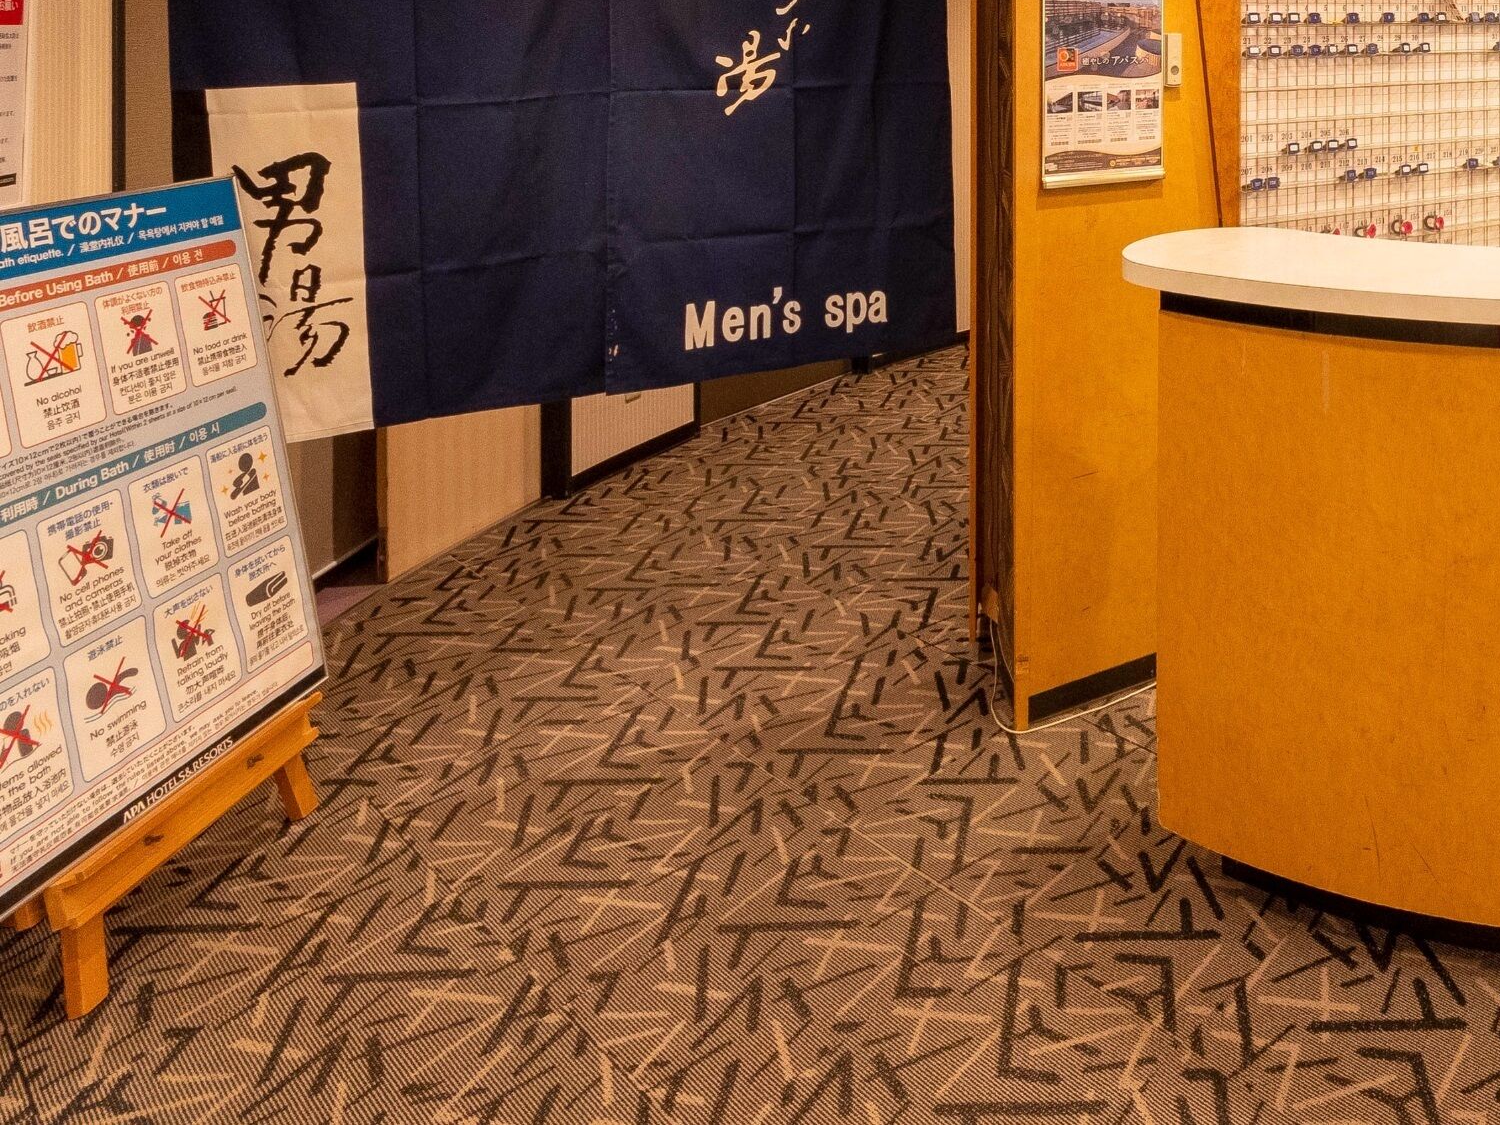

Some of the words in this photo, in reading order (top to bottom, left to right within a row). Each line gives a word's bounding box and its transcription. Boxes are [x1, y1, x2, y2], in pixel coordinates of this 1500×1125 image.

[1, 203, 167, 254] 風呂でのマナー
[17, 248, 64, 266] etiquette.
[128, 259, 159, 277] 使用前
[173, 251, 191, 265] 이용
[194, 248, 203, 261] 전
[232, 152, 353, 377] 男湯
[0, 289, 43, 307] Before
[46, 279, 82, 296] Using
[85, 272, 114, 287] Bath
[181, 272, 237, 293] 飲食物持込み禁止
[103, 286, 163, 309] 体調がよくない方の
[121, 302, 150, 315] 利用禁止
[27, 315, 65, 333] 飲酒禁止
[684, 286, 801, 351] Men's
[825, 290, 888, 333] spa
[193, 347, 204, 356] No
[205, 340, 222, 353] food
[223, 338, 230, 346] or
[231, 332, 248, 343] drink
[111, 365, 117, 374] If
[118, 360, 133, 373] you
[135, 356, 148, 366] are
[151, 347, 175, 361] unwell
[37, 396, 49, 407] No
[51, 385, 82, 403] alcohol
[160, 382, 173, 394] 금지
[43, 398, 80, 419] 禁止饮酒
[47, 418, 62, 431] 음주
[65, 411, 80, 424] 금지
[189, 429, 207, 443] 이용
[211, 422, 220, 434] 시
[144, 441, 175, 464] 使用时
[55, 476, 97, 500] During
[101, 461, 129, 481] Bath
[143, 466, 189, 493] 衣類は脱いで
[1, 497, 38, 523] 利用時
[224, 505, 244, 520] Wash
[245, 498, 259, 512] your
[260, 489, 277, 503] body
[228, 513, 251, 528] before
[251, 499, 277, 520] bathing
[65, 518, 102, 541] 撮影禁止
[162, 536, 181, 550] Take
[182, 529, 193, 541] off
[155, 551, 172, 565] your
[174, 536, 202, 554] clothes
[59, 592, 73, 604] No
[74, 581, 90, 596] cell
[93, 567, 125, 591] phones
[64, 597, 83, 612] and
[86, 578, 124, 602] cameras
[249, 612, 271, 631] leaving
[272, 606, 281, 617] the
[282, 599, 295, 612] bath
[251, 608, 263, 621] Dry
[273, 592, 291, 606] before
[87, 635, 123, 661] 遊泳禁止
[177, 657, 204, 675] Refrain
[206, 645, 224, 659] from
[177, 666, 204, 688] talking
[205, 651, 228, 672] loudly
[89, 729, 105, 742] No
[107, 700, 147, 731] swimming
[27, 743, 63, 773] allowed
[110, 742, 125, 758] 수영
[126, 732, 140, 747] 금지
[8, 782, 26, 798] the
[29, 765, 51, 784] bath
[123, 800, 146, 824] APA
[20, 846, 34, 860] you
[51, 824, 65, 835] not
